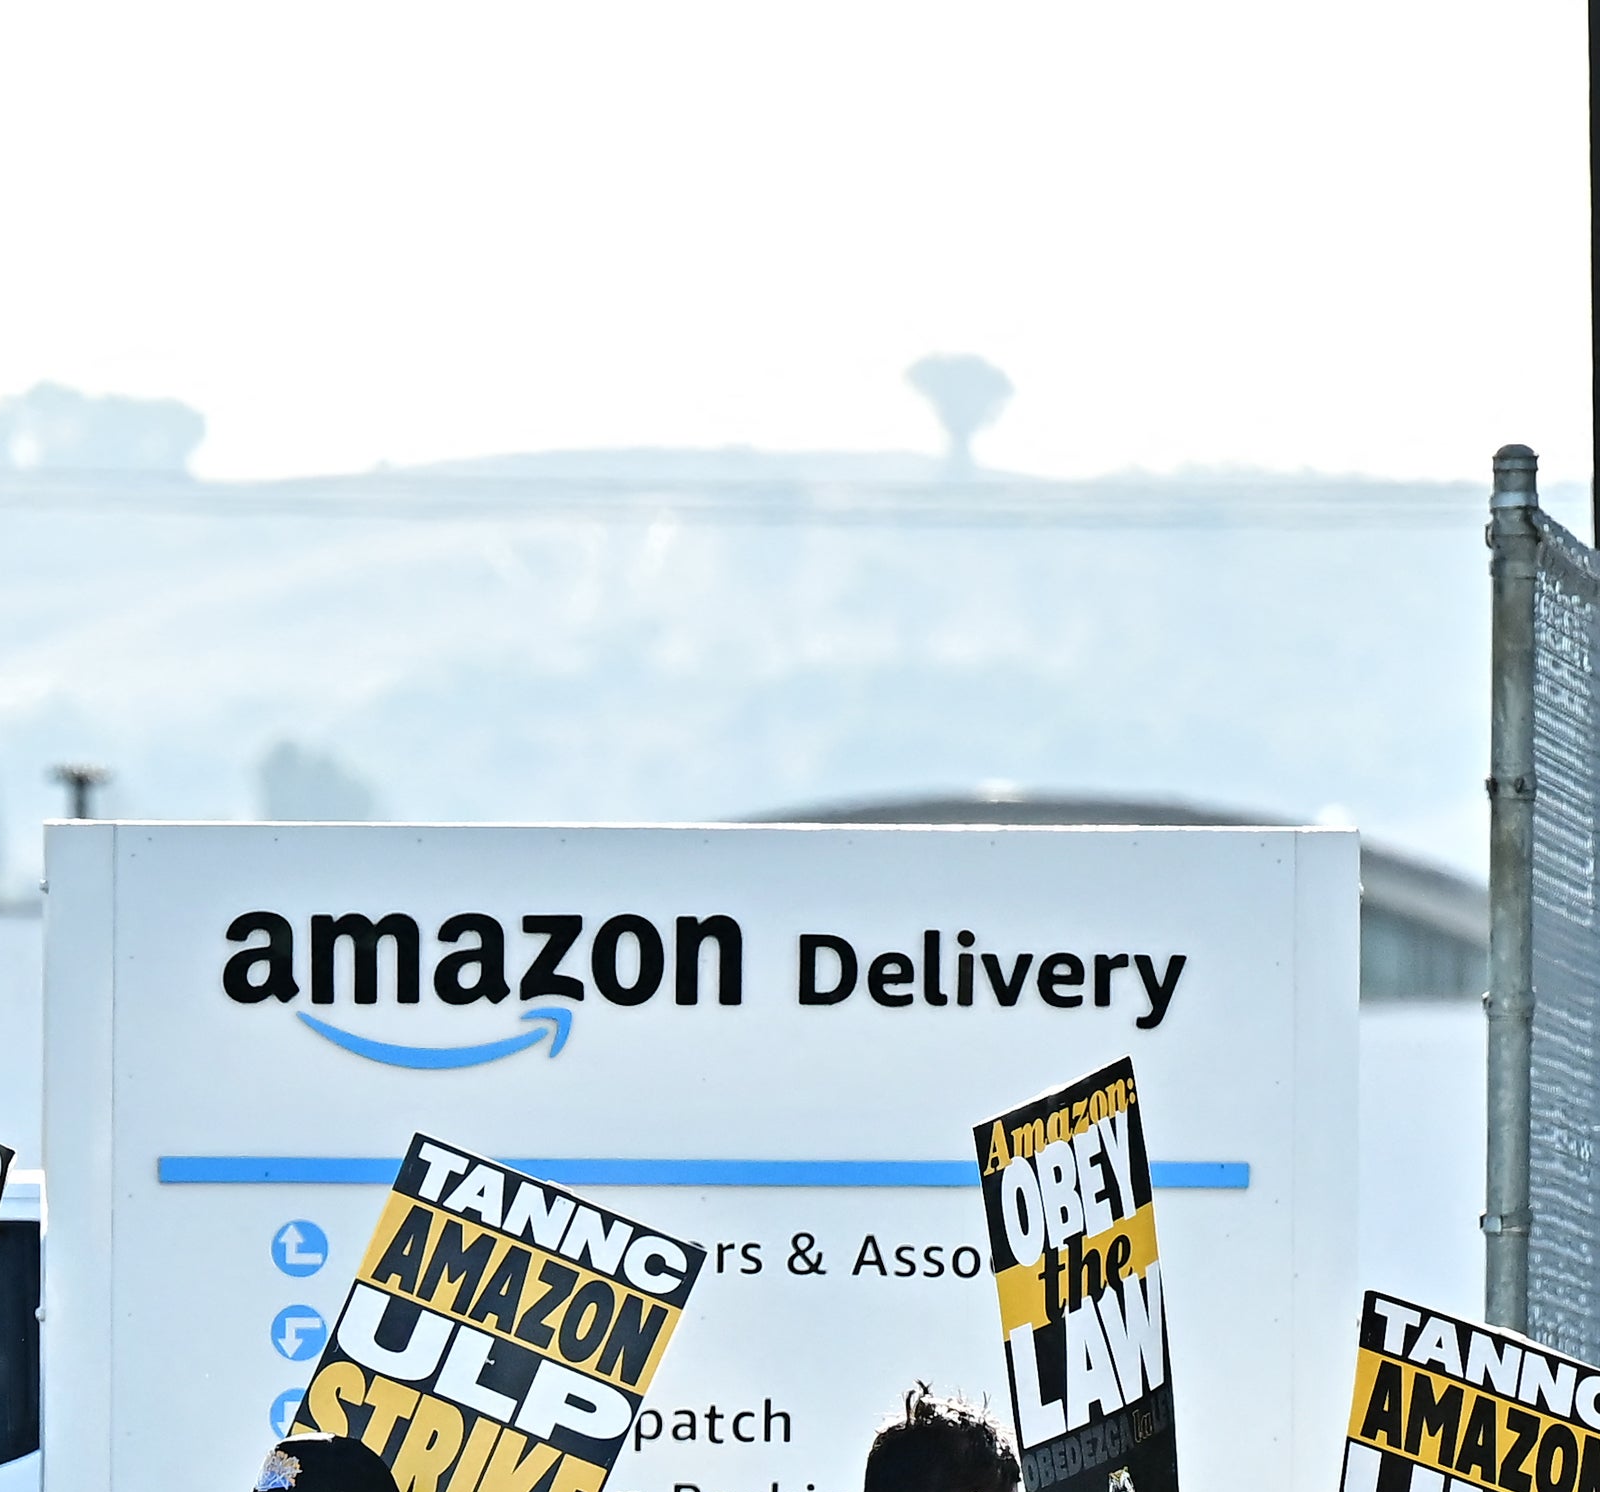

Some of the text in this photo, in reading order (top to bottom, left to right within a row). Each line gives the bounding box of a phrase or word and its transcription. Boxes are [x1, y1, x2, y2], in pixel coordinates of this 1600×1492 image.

[222, 911, 1186, 1029] amazon Delivery
[983, 1077, 1137, 1175] Amazon:
[1002, 1110, 1140, 1268] OBEY
[418, 1141, 690, 1296] TANNC
[703, 1233, 992, 1279] rs & Asso
[1039, 1231, 1133, 1330] the
[337, 1284, 632, 1440] ULP
[374, 1207, 667, 1385] AMAZON
[1009, 1258, 1164, 1451] LAW
[634, 1398, 793, 1452] patch
